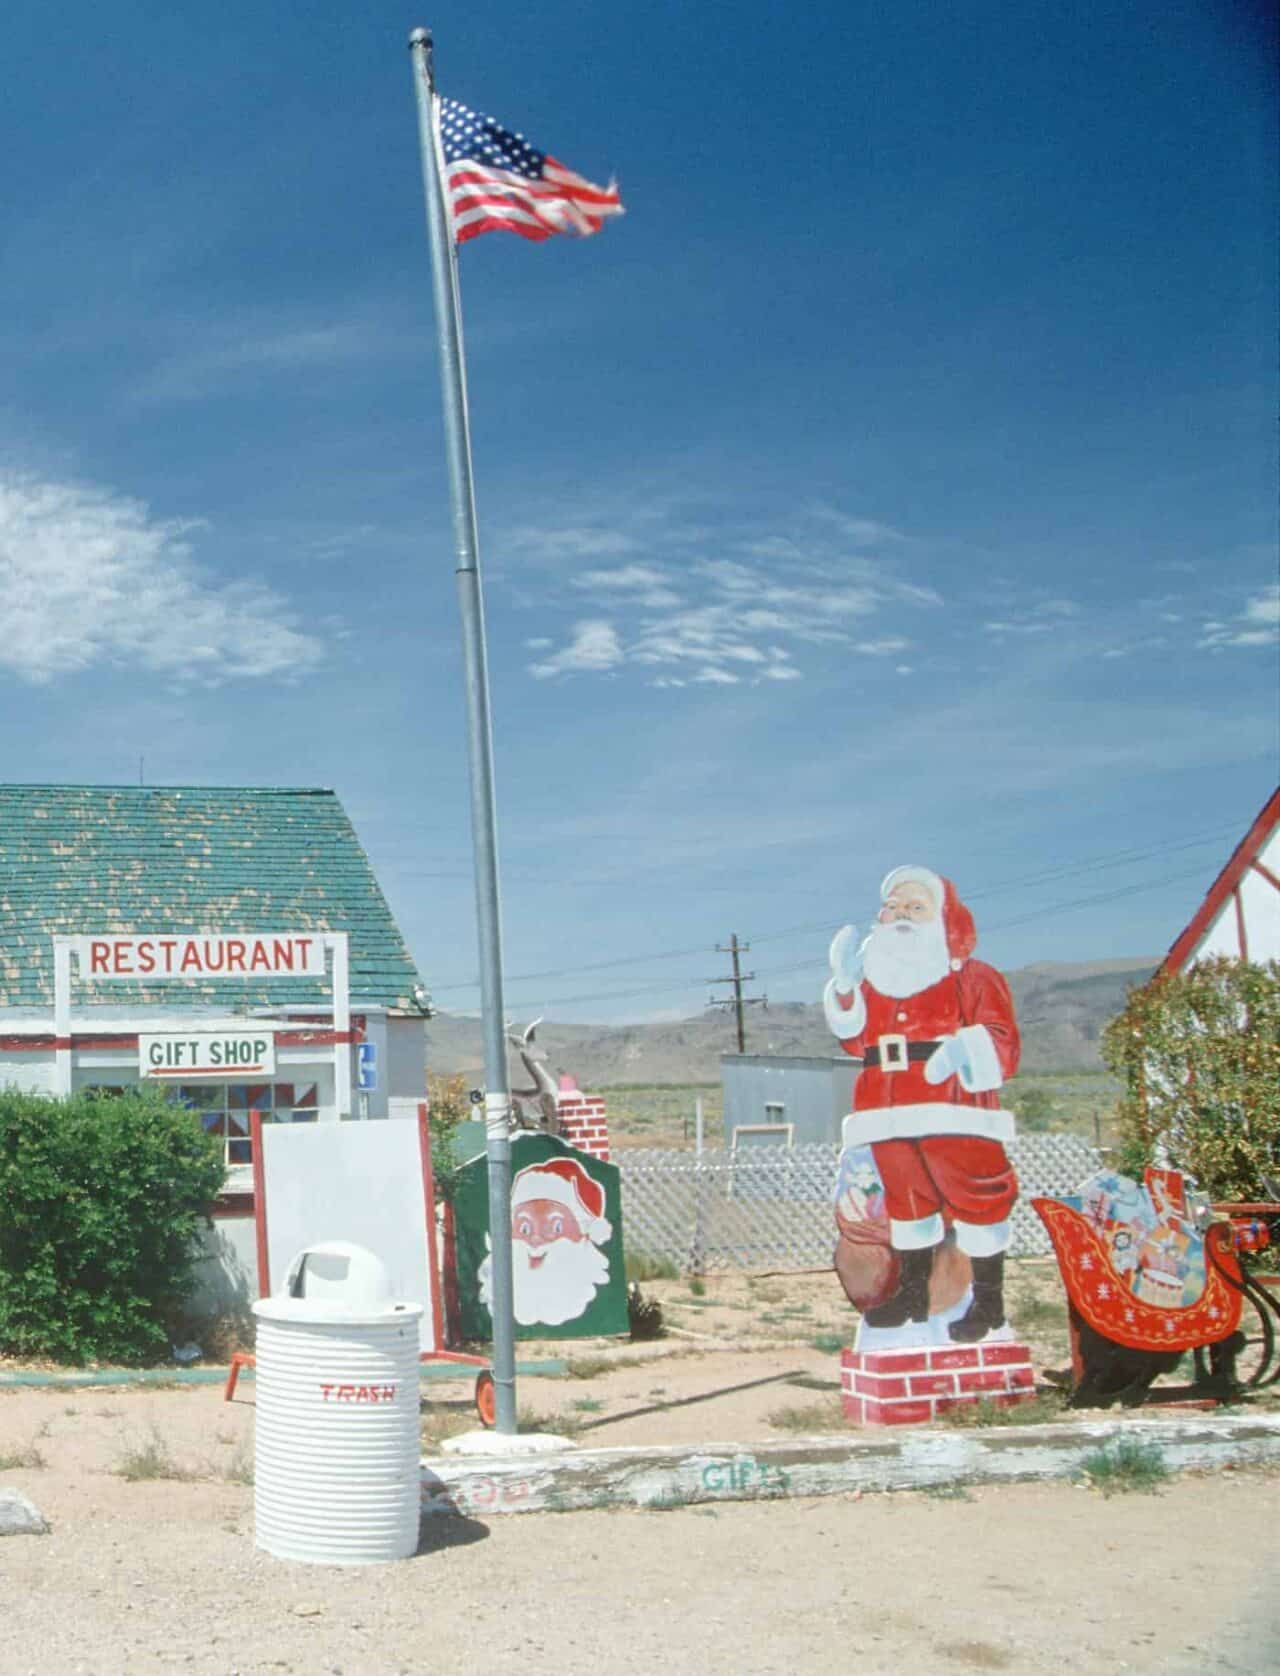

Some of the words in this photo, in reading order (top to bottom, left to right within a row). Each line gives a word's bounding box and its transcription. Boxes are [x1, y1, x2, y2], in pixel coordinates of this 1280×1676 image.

[90, 939, 313, 974] RESTAURANT
[149, 1042, 199, 1066] GIFT
[209, 1039, 267, 1065] SHOP
[320, 1384, 396, 1403] TRASH
